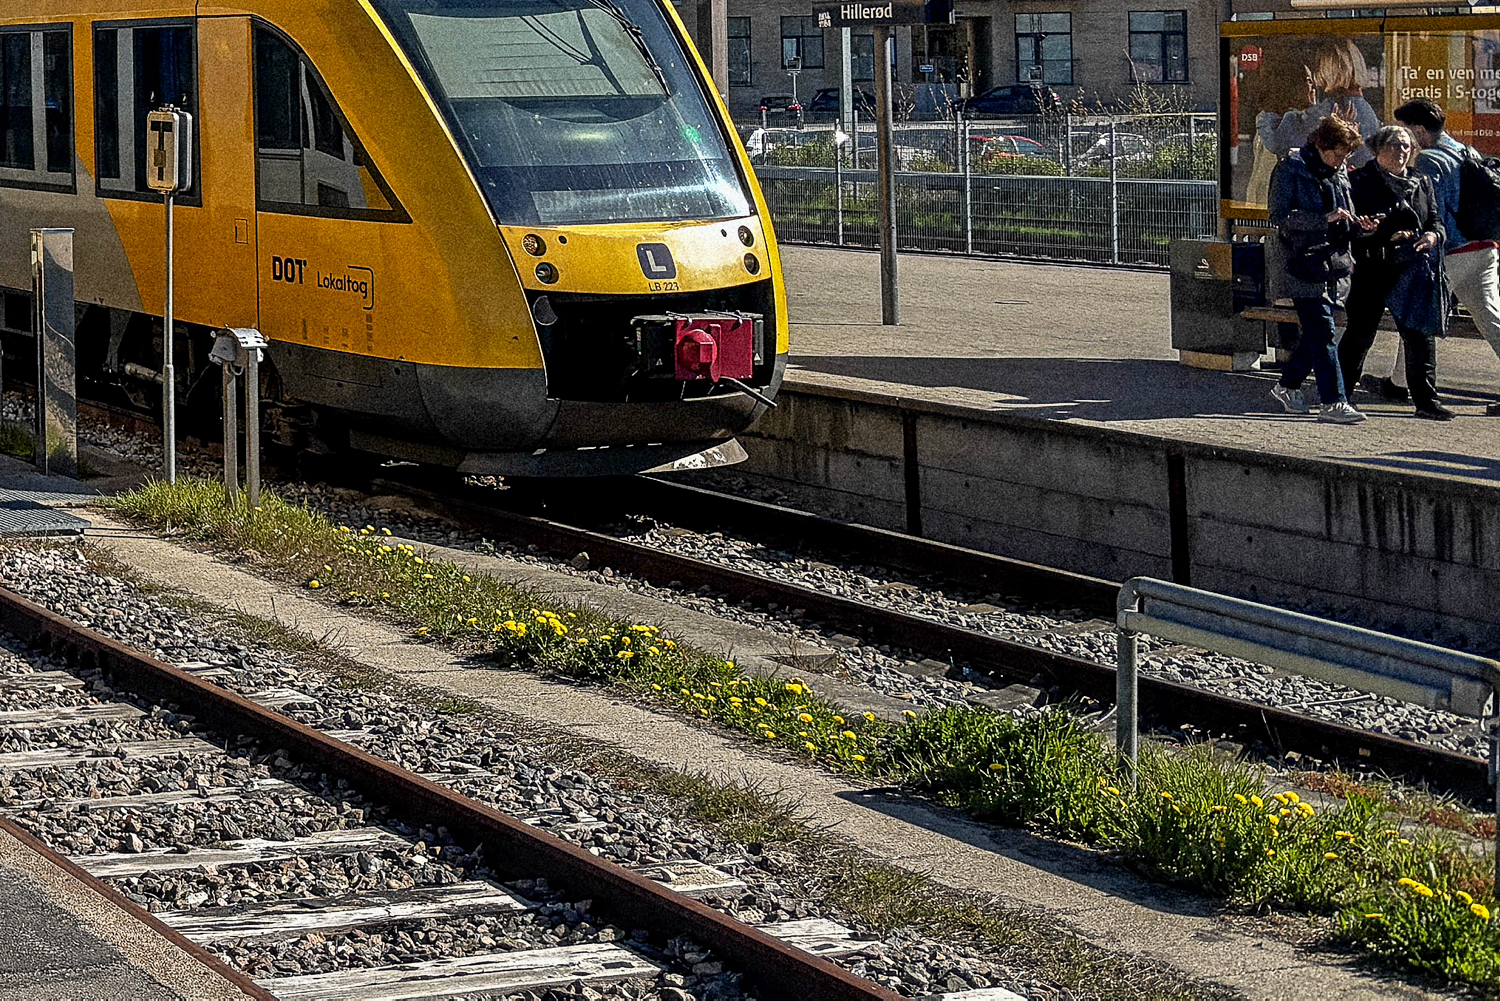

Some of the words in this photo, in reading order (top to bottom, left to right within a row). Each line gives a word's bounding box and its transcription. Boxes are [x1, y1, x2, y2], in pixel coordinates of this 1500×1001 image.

[840, 2, 893, 20] Hillerød
[1241, 53, 1258, 62] DSB
[1426, 68, 1445, 80] en
[1449, 68, 1475, 80] ven
[1402, 85, 1442, 100] gratis
[645, 250, 667, 272] L
[272, 255, 306, 285] DOT
[317, 271, 368, 300] Lokaltog
[648, 282, 662, 292] LB
